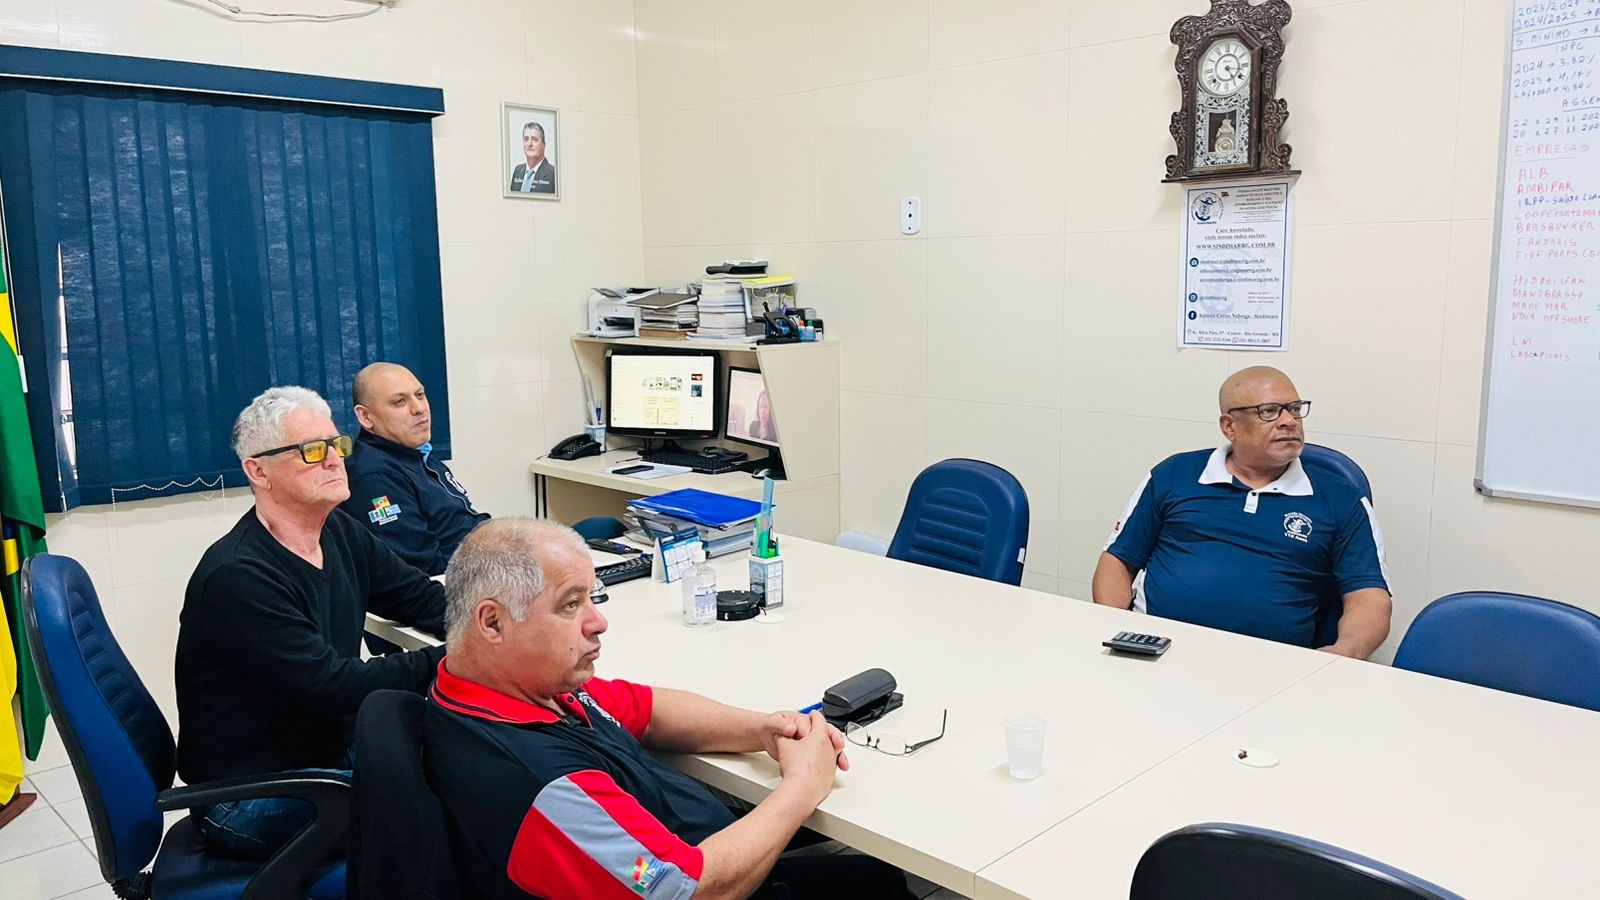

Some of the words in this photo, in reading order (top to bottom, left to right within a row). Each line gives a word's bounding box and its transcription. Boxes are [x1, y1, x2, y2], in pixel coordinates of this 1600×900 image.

[1580, 111, 1600, 121] 202
[1514, 143, 1590, 157] EMPRESAS
[1517, 181, 1575, 195] AMBIPAR
